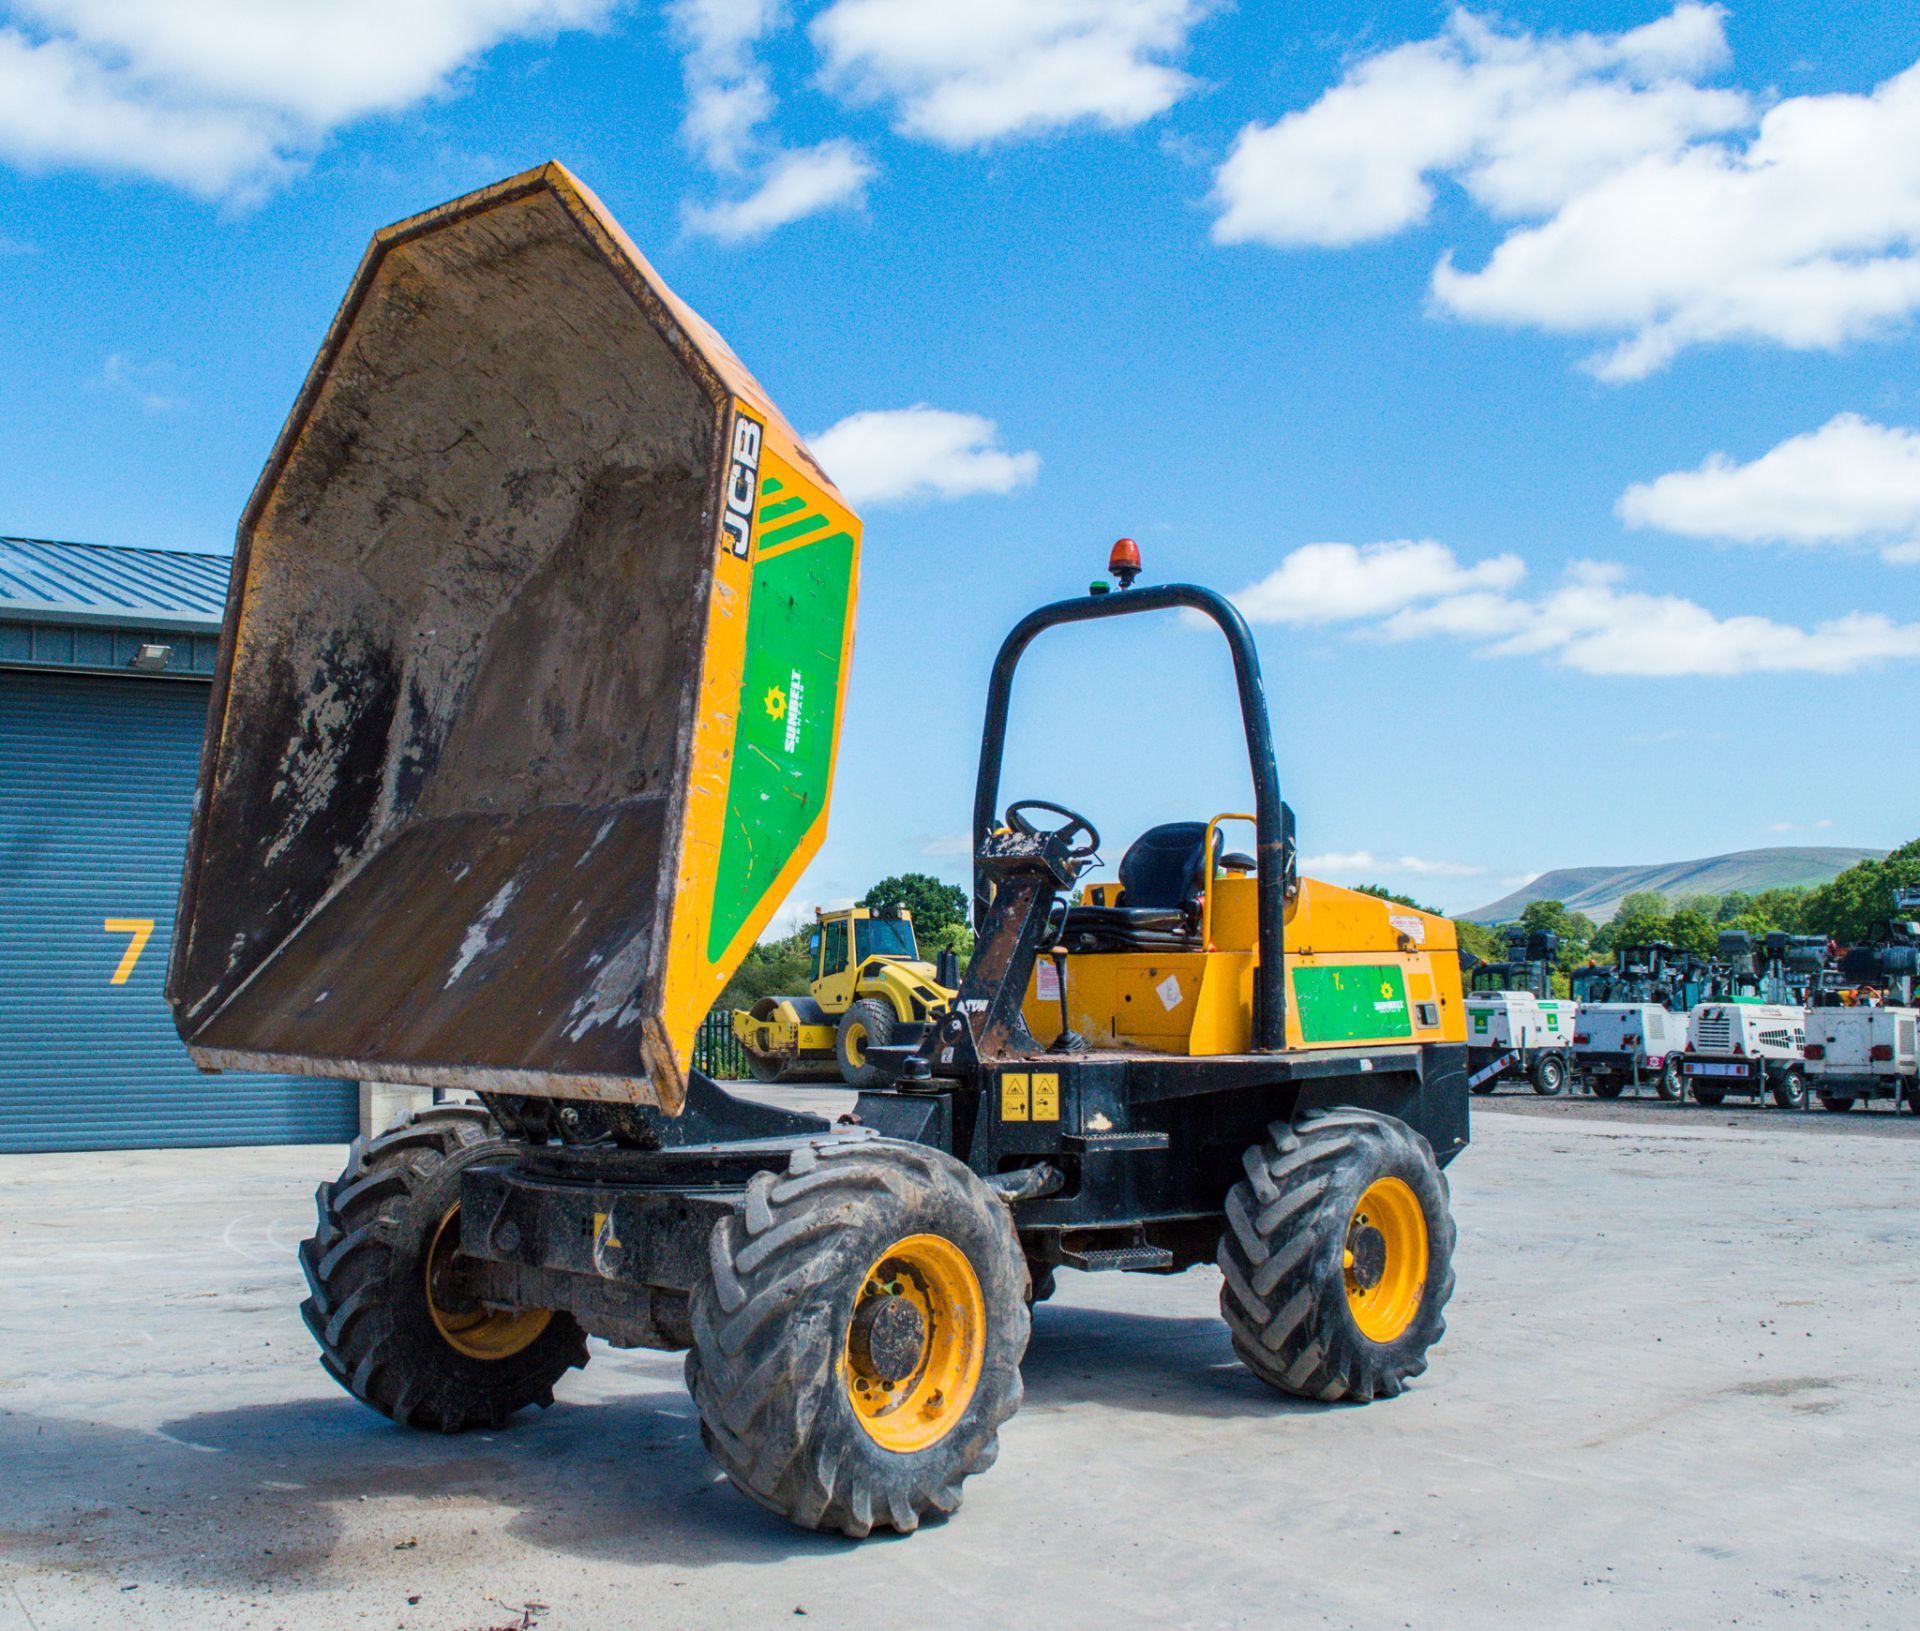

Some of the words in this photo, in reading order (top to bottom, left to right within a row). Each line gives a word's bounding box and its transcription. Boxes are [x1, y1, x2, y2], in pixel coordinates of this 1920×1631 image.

[724, 417, 761, 556] JCB
[784, 668, 801, 754] SUNBELT
[104, 918, 155, 985] 7
